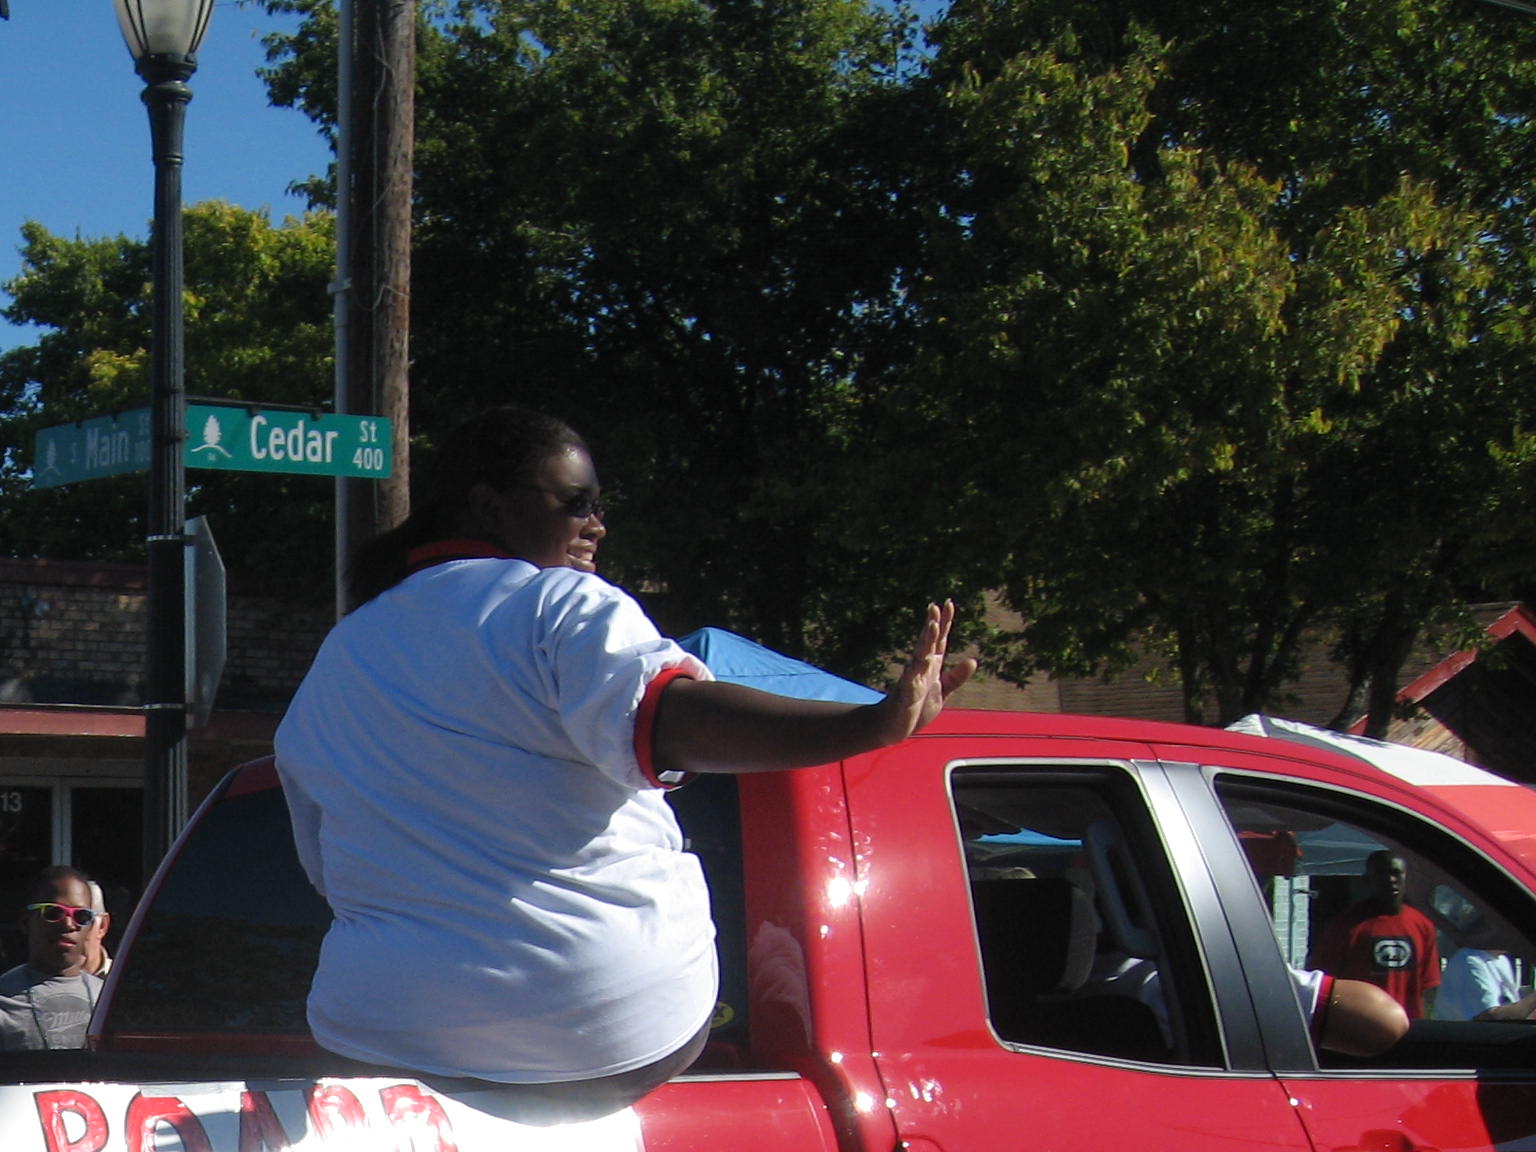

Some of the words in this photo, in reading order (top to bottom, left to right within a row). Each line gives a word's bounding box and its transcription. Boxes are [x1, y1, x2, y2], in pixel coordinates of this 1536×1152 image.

[85, 423, 129, 471] Main
[250, 414, 338, 464] Cedar
[359, 420, 377, 443] St
[352, 447, 384, 471] 400
